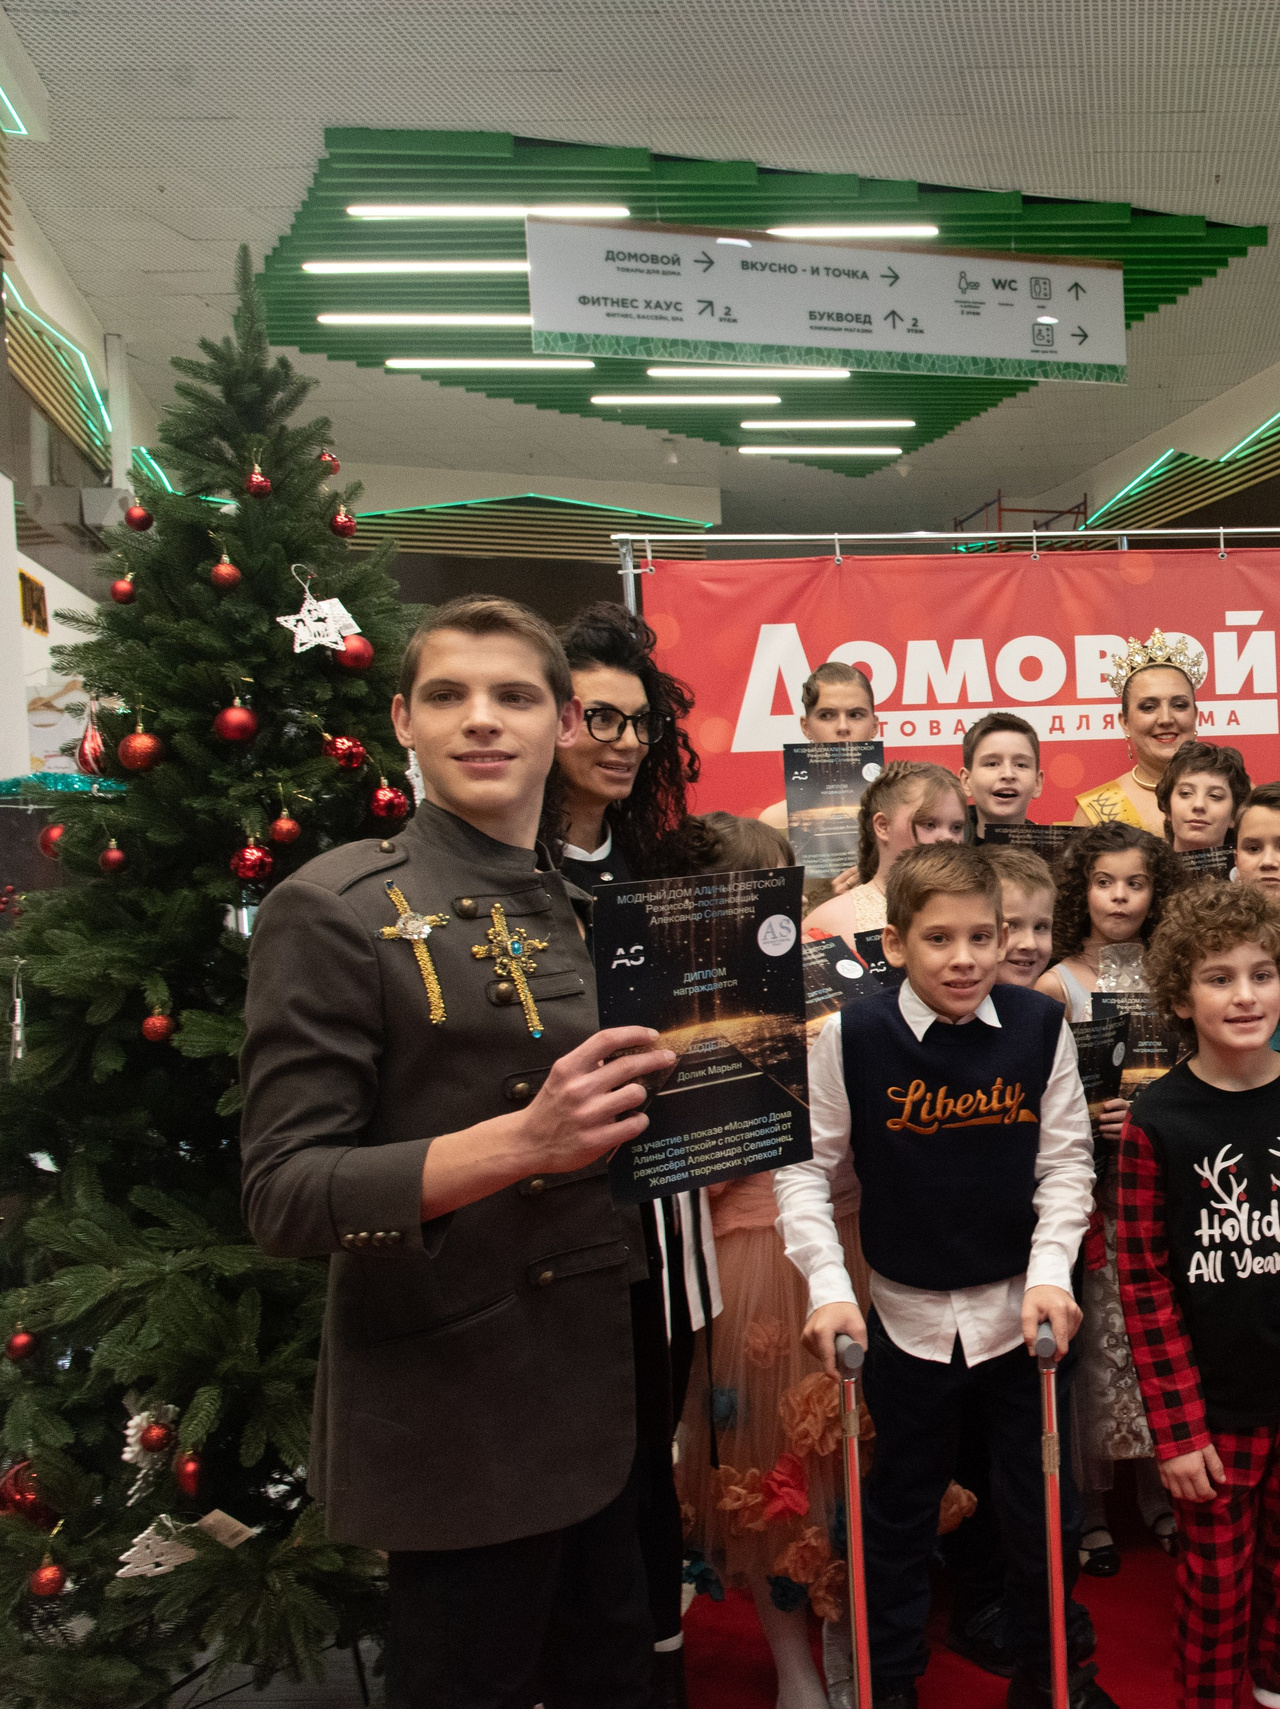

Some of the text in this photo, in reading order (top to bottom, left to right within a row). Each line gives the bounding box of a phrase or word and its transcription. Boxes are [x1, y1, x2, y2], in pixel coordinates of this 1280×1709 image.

[605, 250, 681, 266] ДОМОВОЙ
[741, 260, 798, 275] ВКУСНО
[811, 266, 820, 276] И
[824, 267, 870, 280] ТОЧКА
[992, 278, 1018, 291] WC
[578, 295, 683, 312] ФИТНЕС ХАУС
[723, 306, 732, 317] 2
[809, 311, 872, 326] БУКВОЕД
[911, 318, 918, 327] 2
[872, 718, 967, 738] ТОВА
[1049, 713, 1114, 734] ДЛЯ
[617, 888, 667, 905] МОДНЫЙ
[668, 888, 693, 901] ДОМ
[732, 876, 786, 893] СВЕТСКОЙ
[649, 905, 756, 926] Александр Селивонец
[761, 918, 792, 941] AS
[610, 944, 646, 970] AS
[683, 966, 727, 984] ДИПЛОМ
[673, 979, 738, 997] награждается
[677, 1061, 743, 1083] Долик Марьян
[886, 1076, 1038, 1134] Liberty
[631, 1109, 793, 1154] за участие в показе «Модного Дома
[633, 1121, 793, 1166] Алины Светской» с постановкой от
[633, 1158, 687, 1180] режиссёра
[687, 1147, 742, 1166] Александра
[649, 1171, 689, 1188] Желаем
[690, 1158, 743, 1177] творческих
[1187, 1250, 1223, 1284] All
